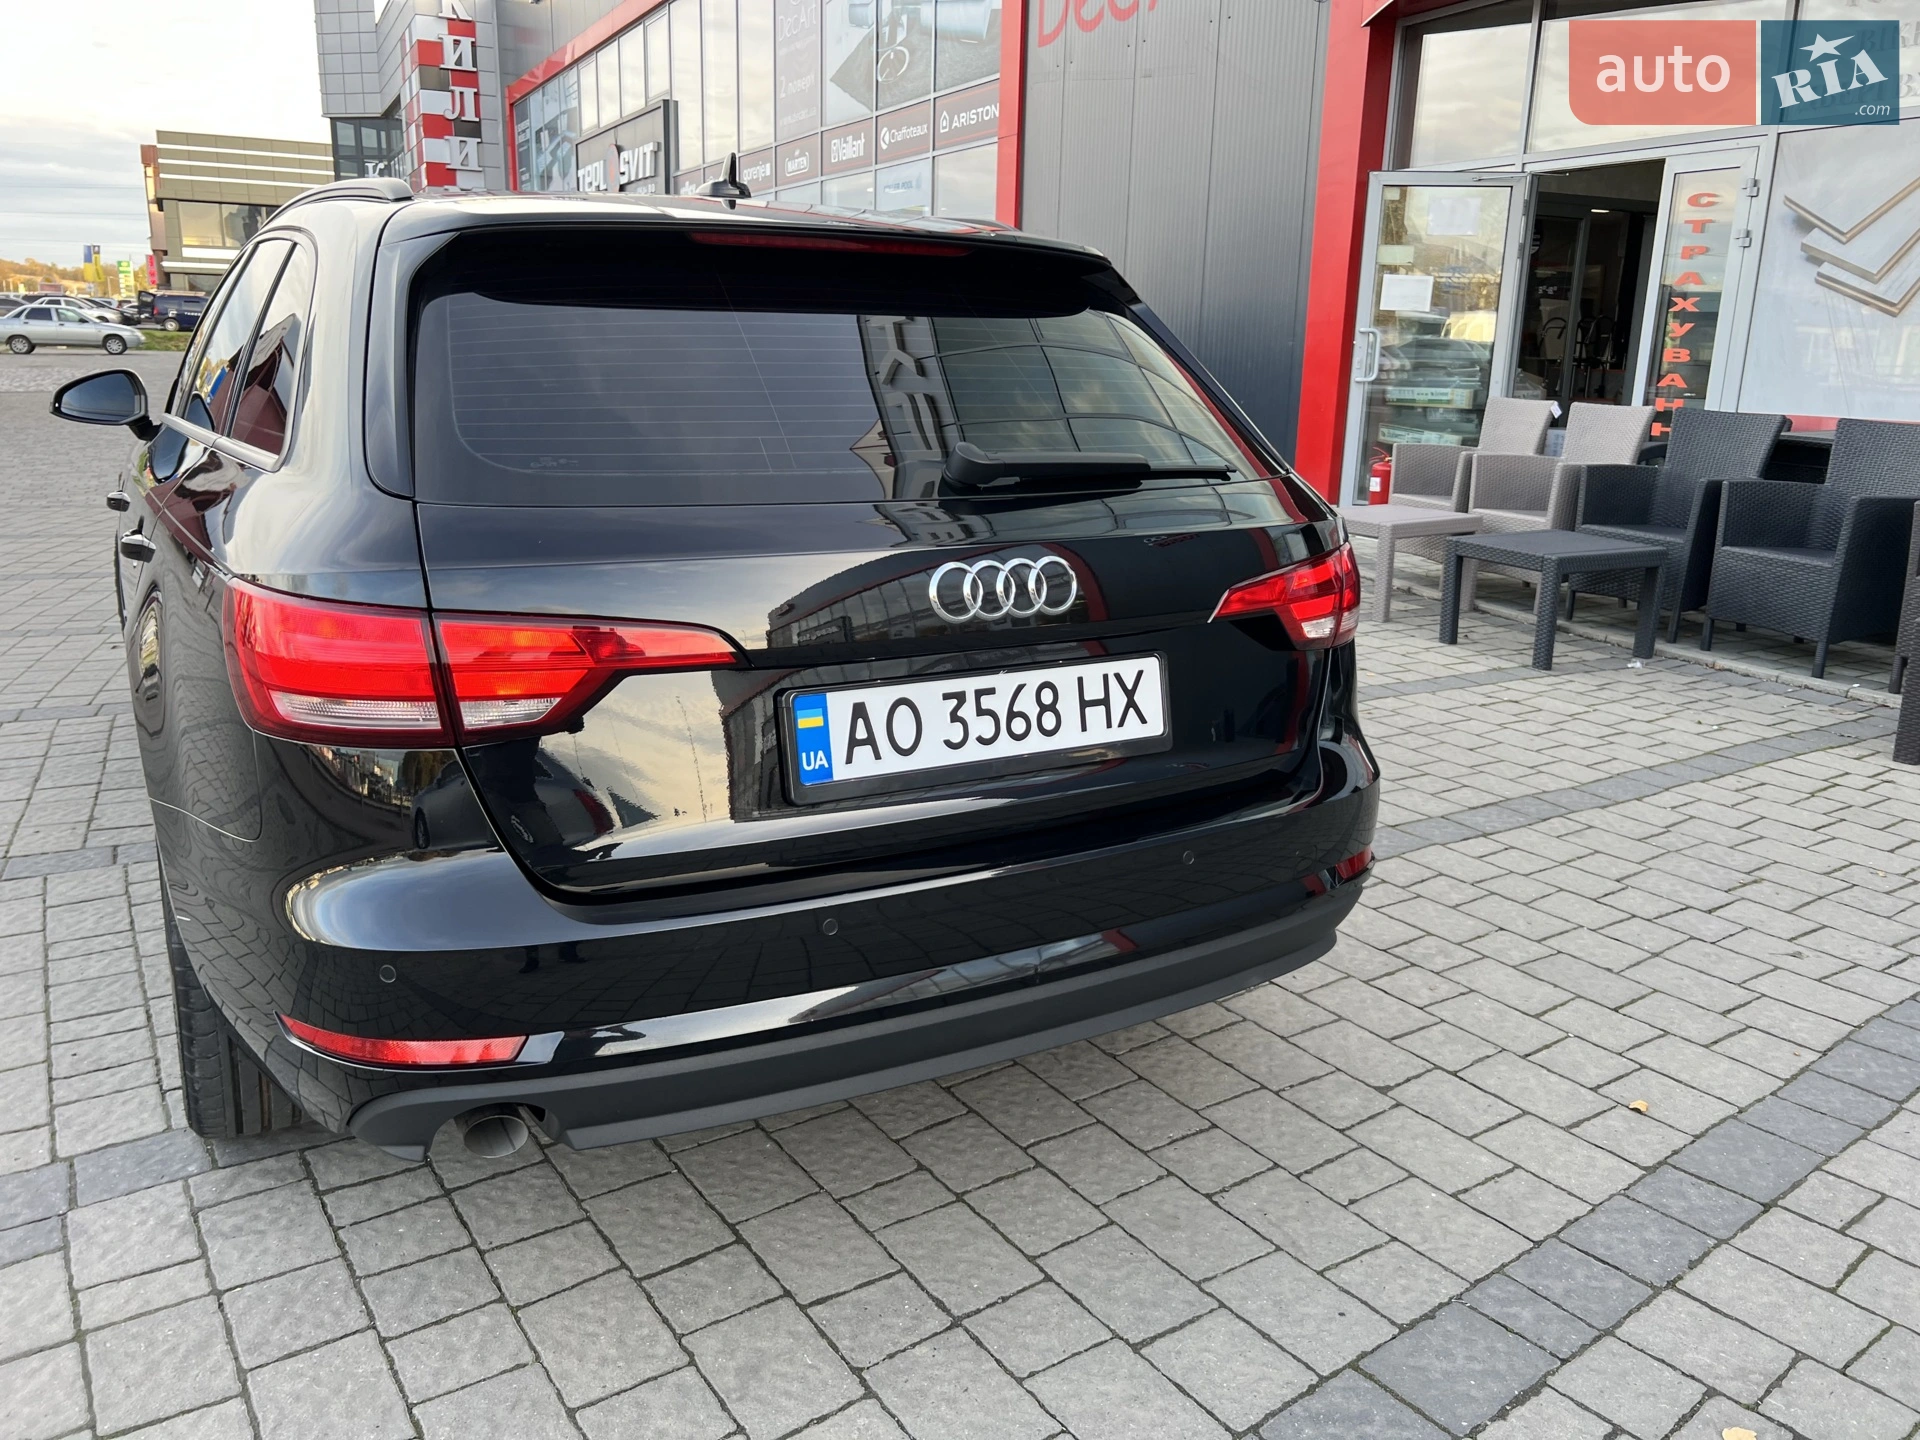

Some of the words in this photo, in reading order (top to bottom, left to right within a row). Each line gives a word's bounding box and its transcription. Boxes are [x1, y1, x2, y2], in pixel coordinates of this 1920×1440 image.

[437, 0, 487, 191] КИЛИ
[952, 102, 1000, 129] ARISTON
[890, 122, 928, 143] Chaffoteaux
[837, 132, 866, 161] Vaillant
[743, 161, 766, 183] gorenje
[844, 696, 923, 765] AO
[941, 680, 1063, 751] 3568
[1076, 669, 1149, 733] HX
[802, 750, 829, 771] UA
